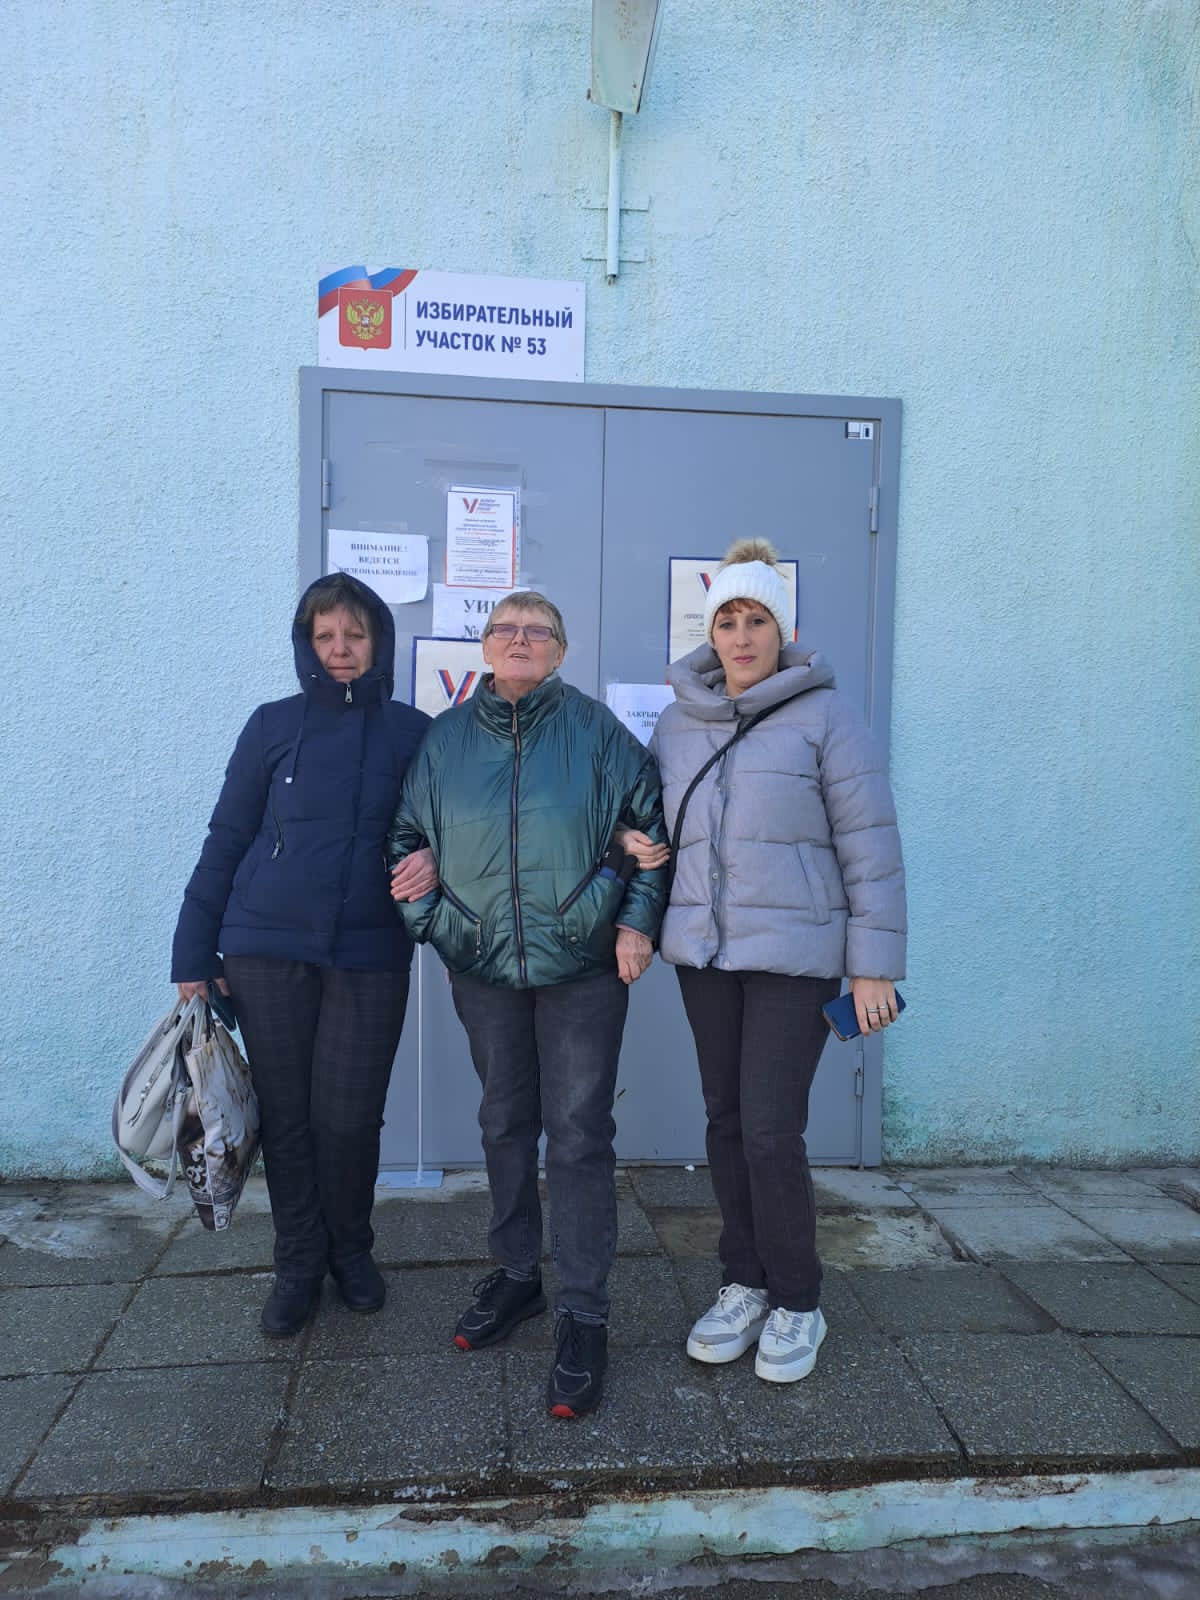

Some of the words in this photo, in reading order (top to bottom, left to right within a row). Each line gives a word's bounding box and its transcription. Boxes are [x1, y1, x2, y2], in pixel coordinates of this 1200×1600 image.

[416, 300, 573, 328] ИЗБИРАТЕЛЬНЫЙ
[416, 329, 496, 352] УЧАСТОК
[501, 335, 522, 353] №
[527, 337, 547, 355] 53
